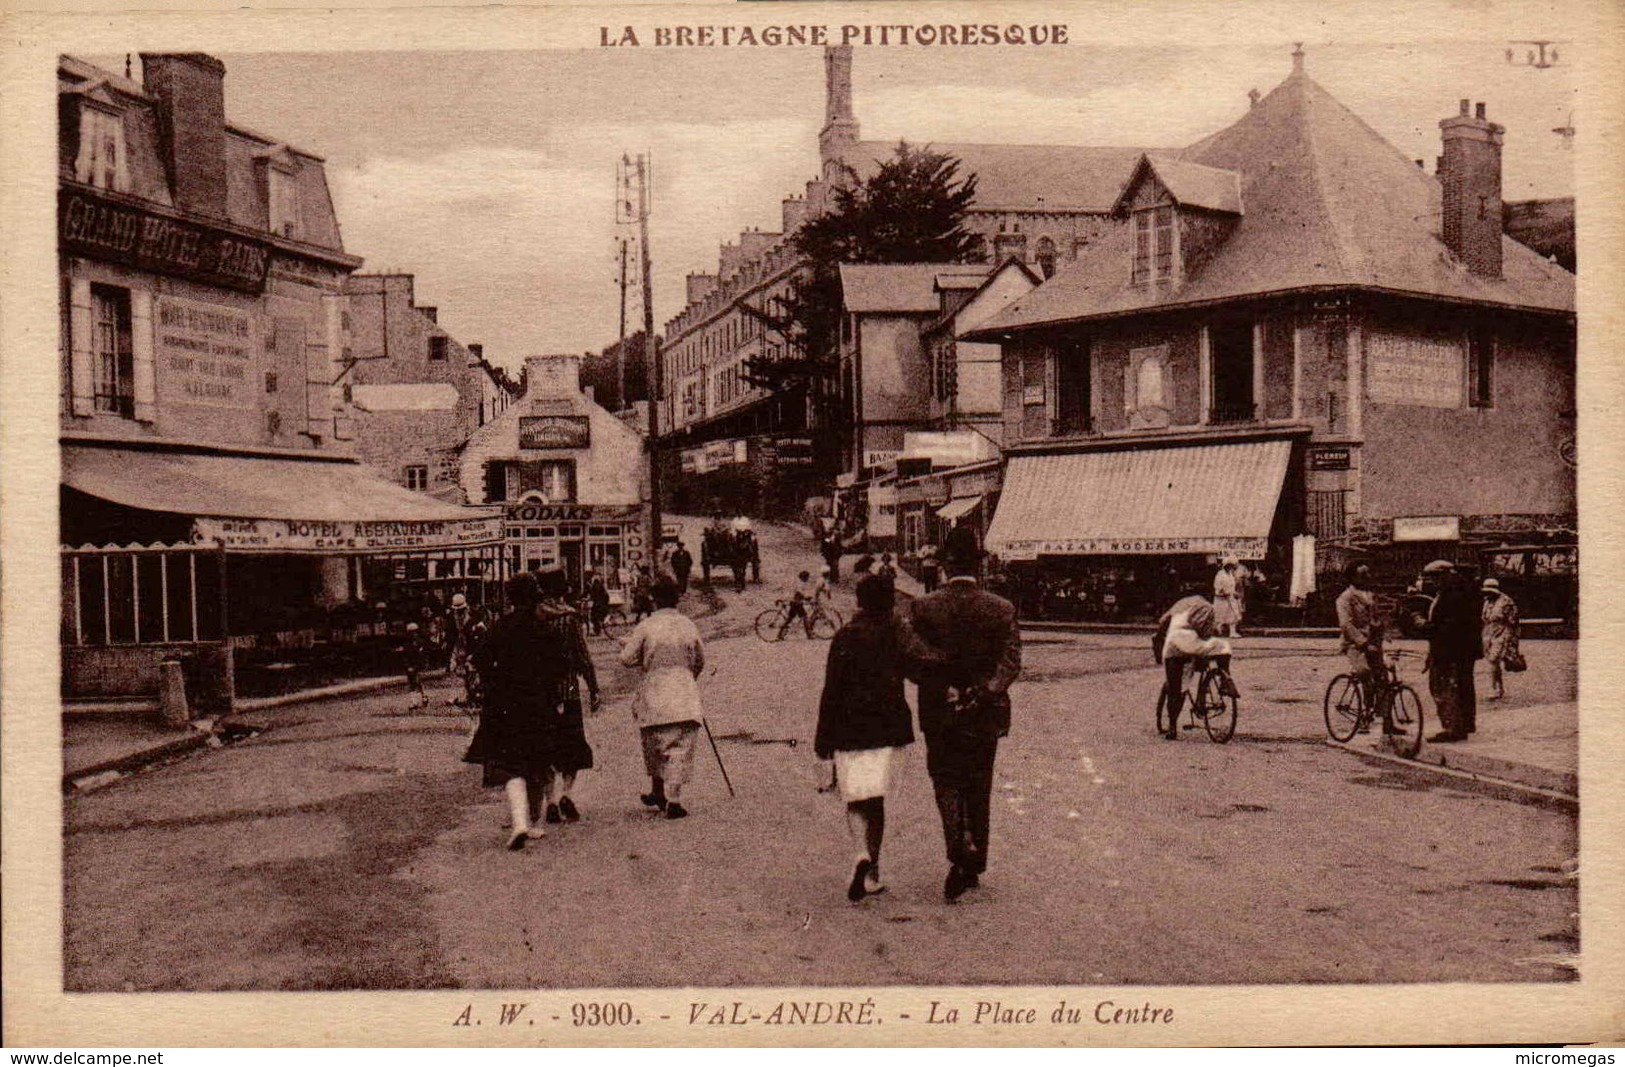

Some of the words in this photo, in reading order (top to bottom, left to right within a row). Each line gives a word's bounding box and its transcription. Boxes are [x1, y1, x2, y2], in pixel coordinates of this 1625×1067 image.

[506, 505, 592, 521] KODAKS
[354, 521, 445, 538] RESTAURANT
[366, 536, 424, 547] GLACIER
[1044, 543, 1097, 551] BAZAR
[1110, 541, 1190, 551] MODERNE
